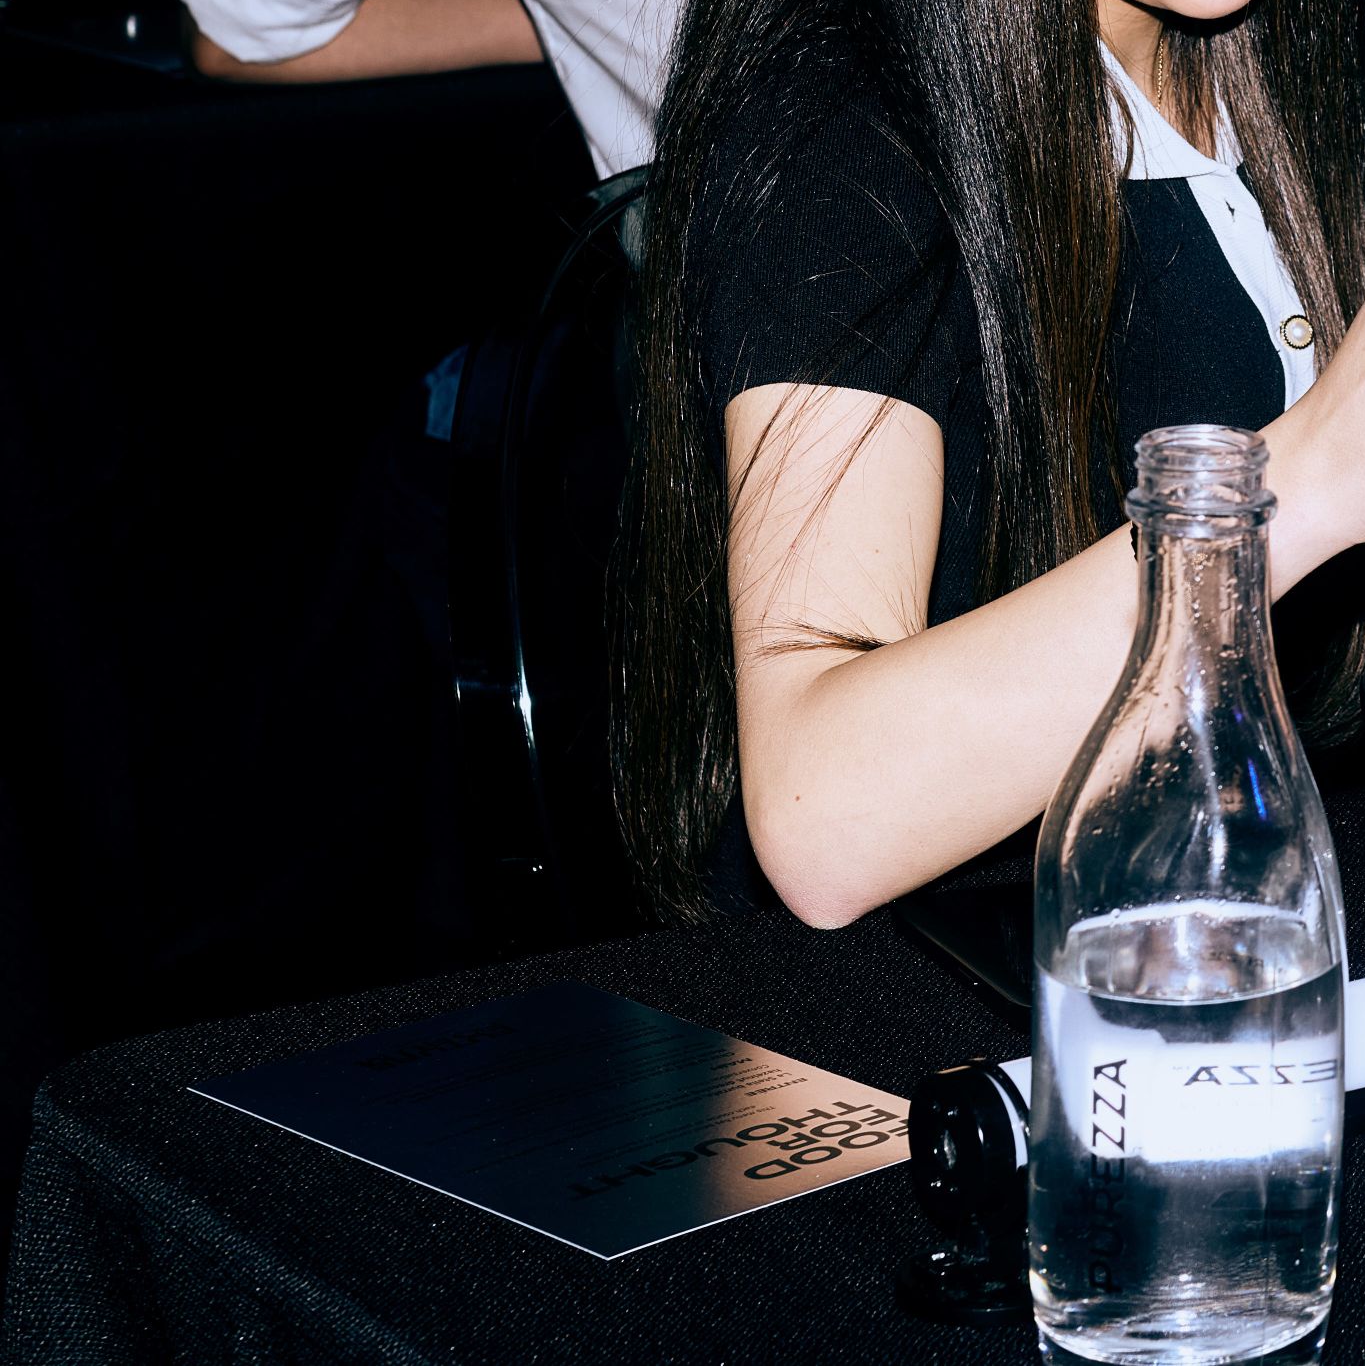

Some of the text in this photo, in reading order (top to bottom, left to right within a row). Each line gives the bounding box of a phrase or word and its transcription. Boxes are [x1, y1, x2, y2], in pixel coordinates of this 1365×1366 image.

[567, 1101, 875, 1202] THOUGHT
[766, 1108, 901, 1151] FOR
[1086, 1059, 1128, 1294] PUREZZA
